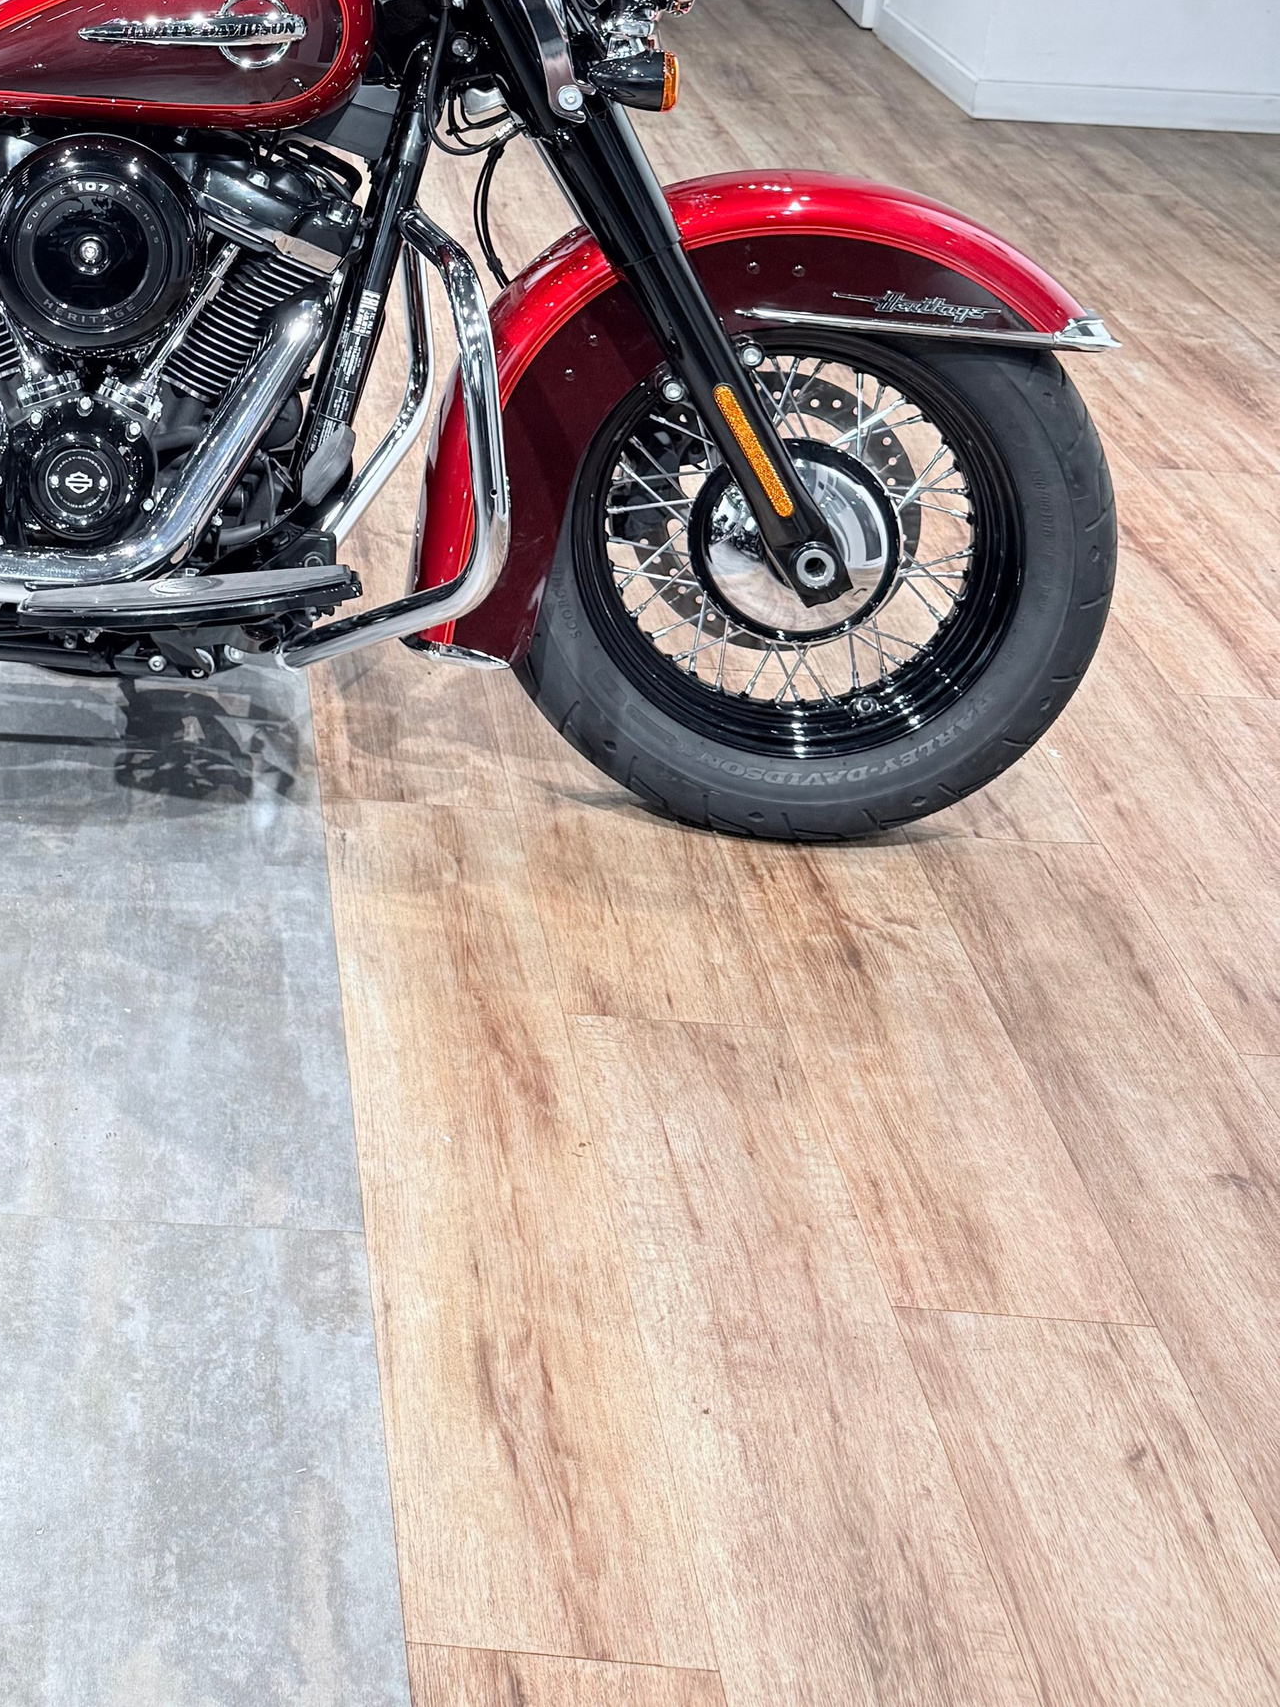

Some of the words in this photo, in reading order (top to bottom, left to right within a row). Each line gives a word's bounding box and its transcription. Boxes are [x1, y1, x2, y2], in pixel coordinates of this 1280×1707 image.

[27, 189, 66, 230] CUBIC
[77, 181, 110, 192] 107
[115, 190, 159, 244] INCHES
[43, 298, 136, 323] HERITAGE
